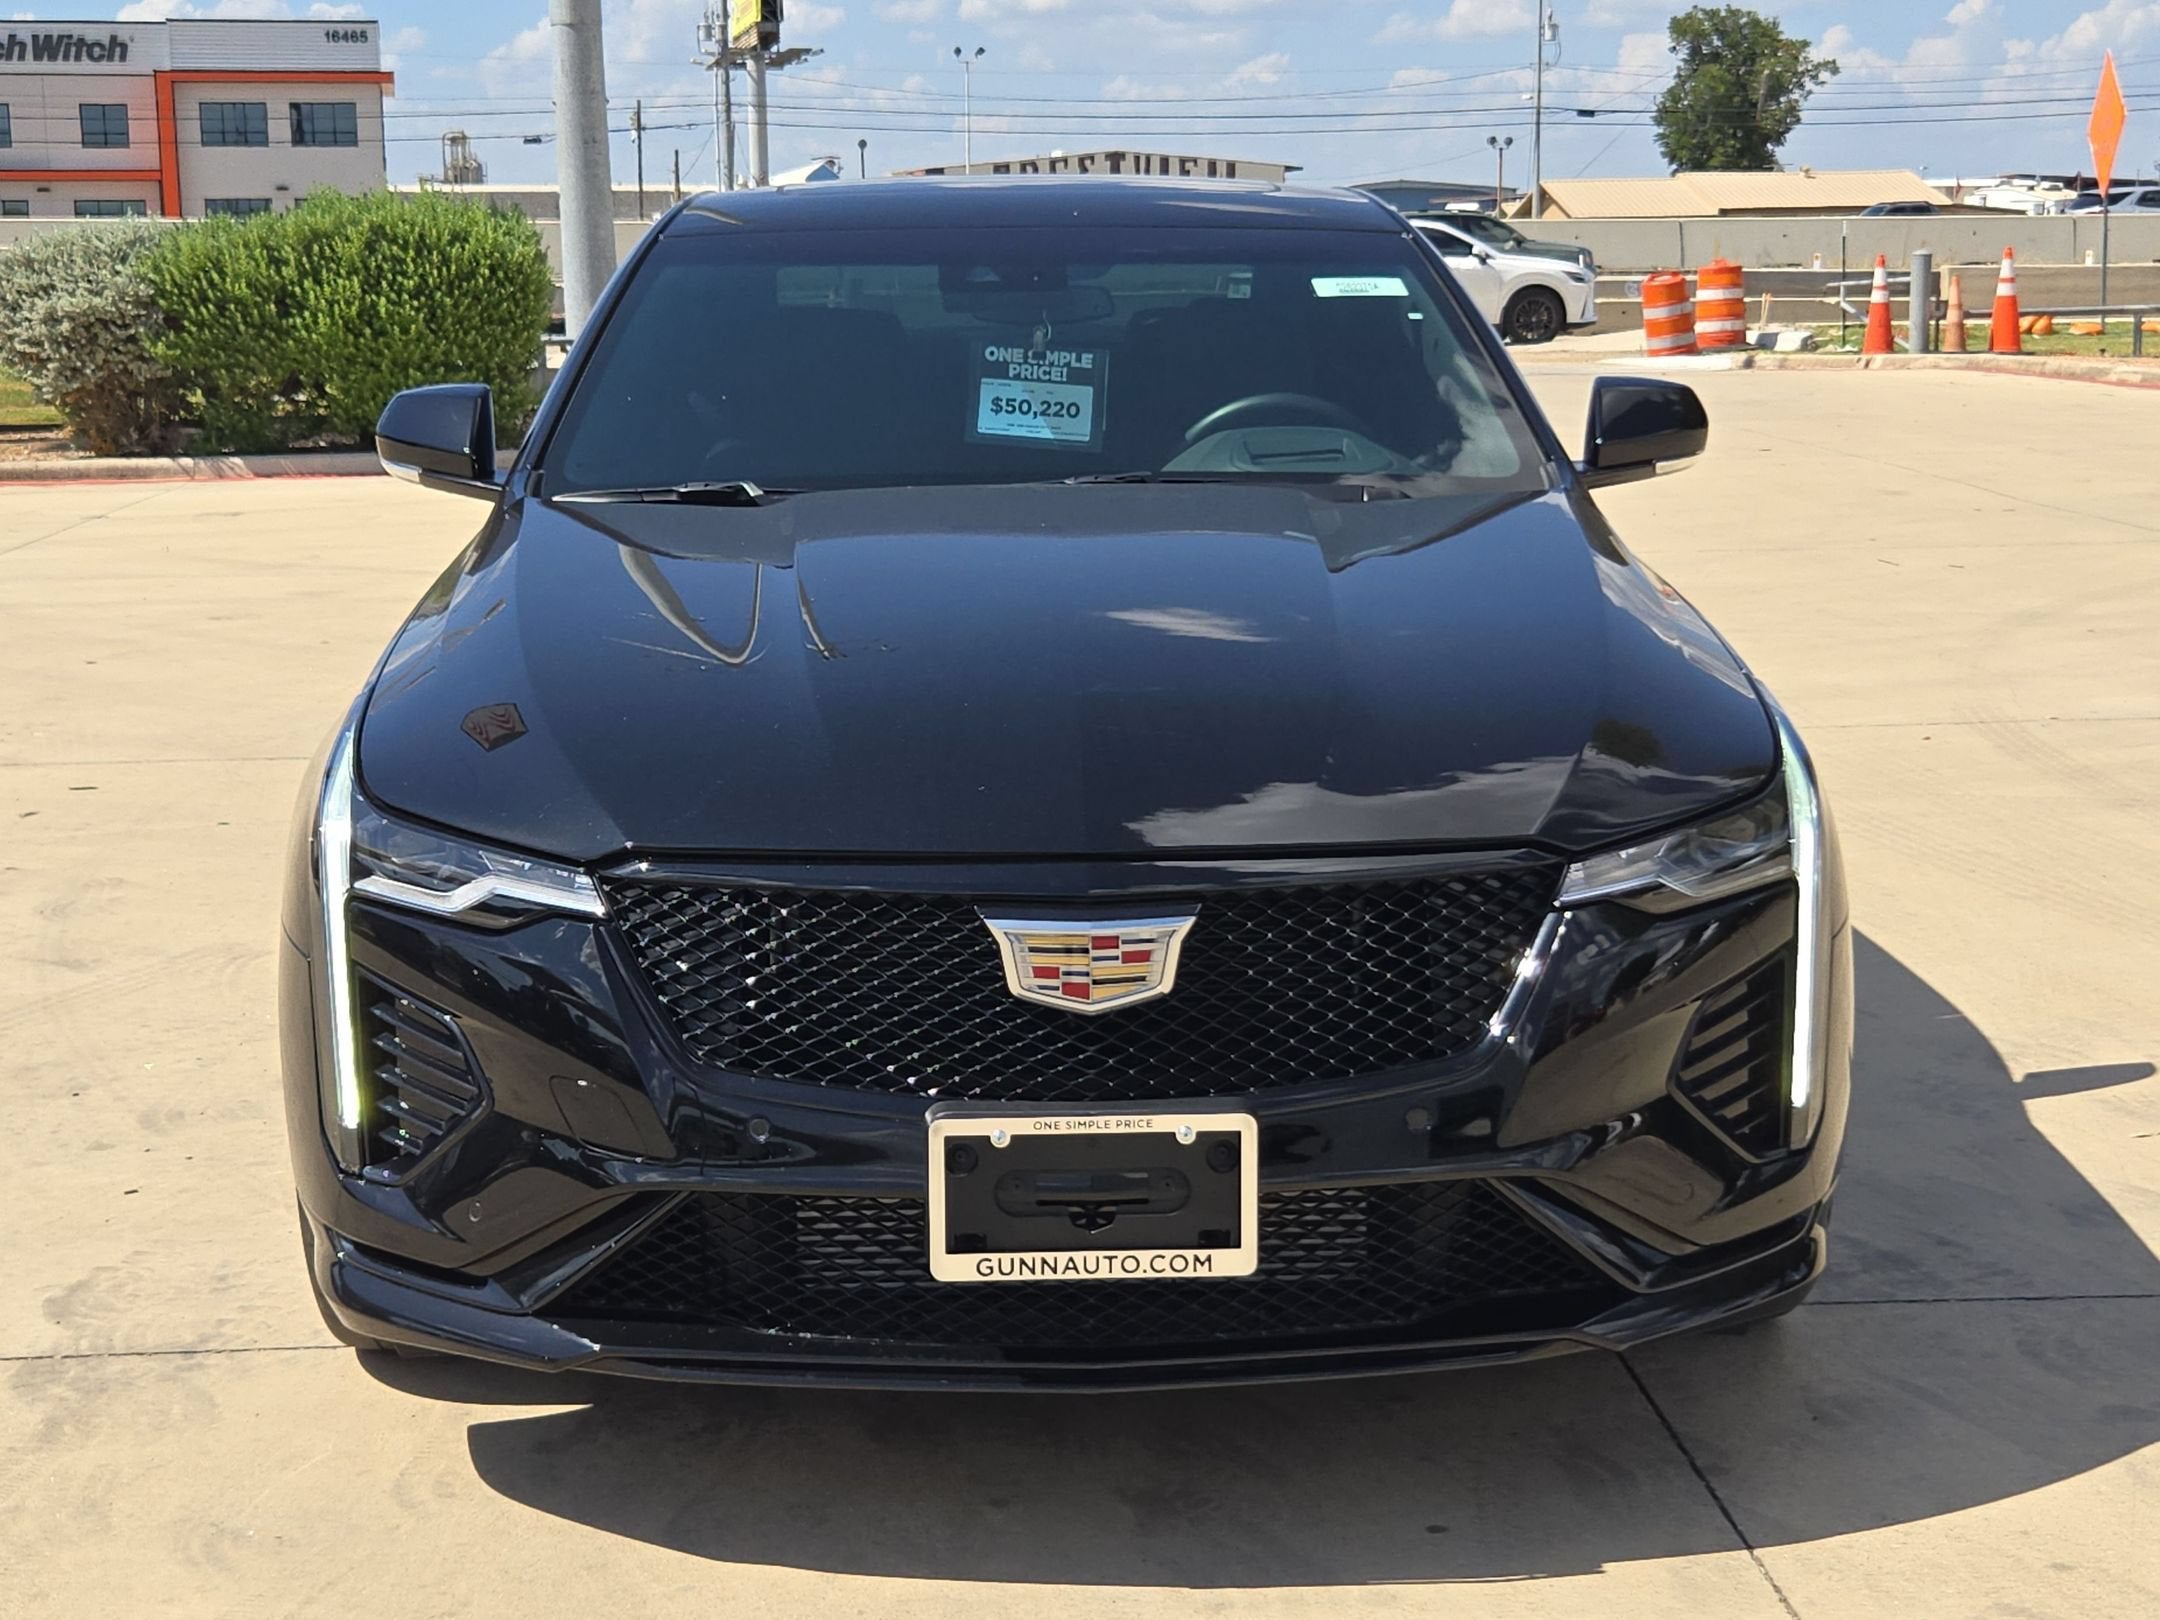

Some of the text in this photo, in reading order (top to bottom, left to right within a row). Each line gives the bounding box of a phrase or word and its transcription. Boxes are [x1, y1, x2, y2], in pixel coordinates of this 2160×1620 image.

[324, 29, 369, 44] 16465
[31, 34, 129, 63] Witch
[984, 346, 1094, 369] ONE SMPLE
[1008, 364, 1068, 382] PRICE!
[990, 396, 1081, 420] $50,220
[1033, 1118, 1154, 1131] ONE SIMPLE PRICE
[976, 1253, 1214, 1277] GUNNAUTO.COM
